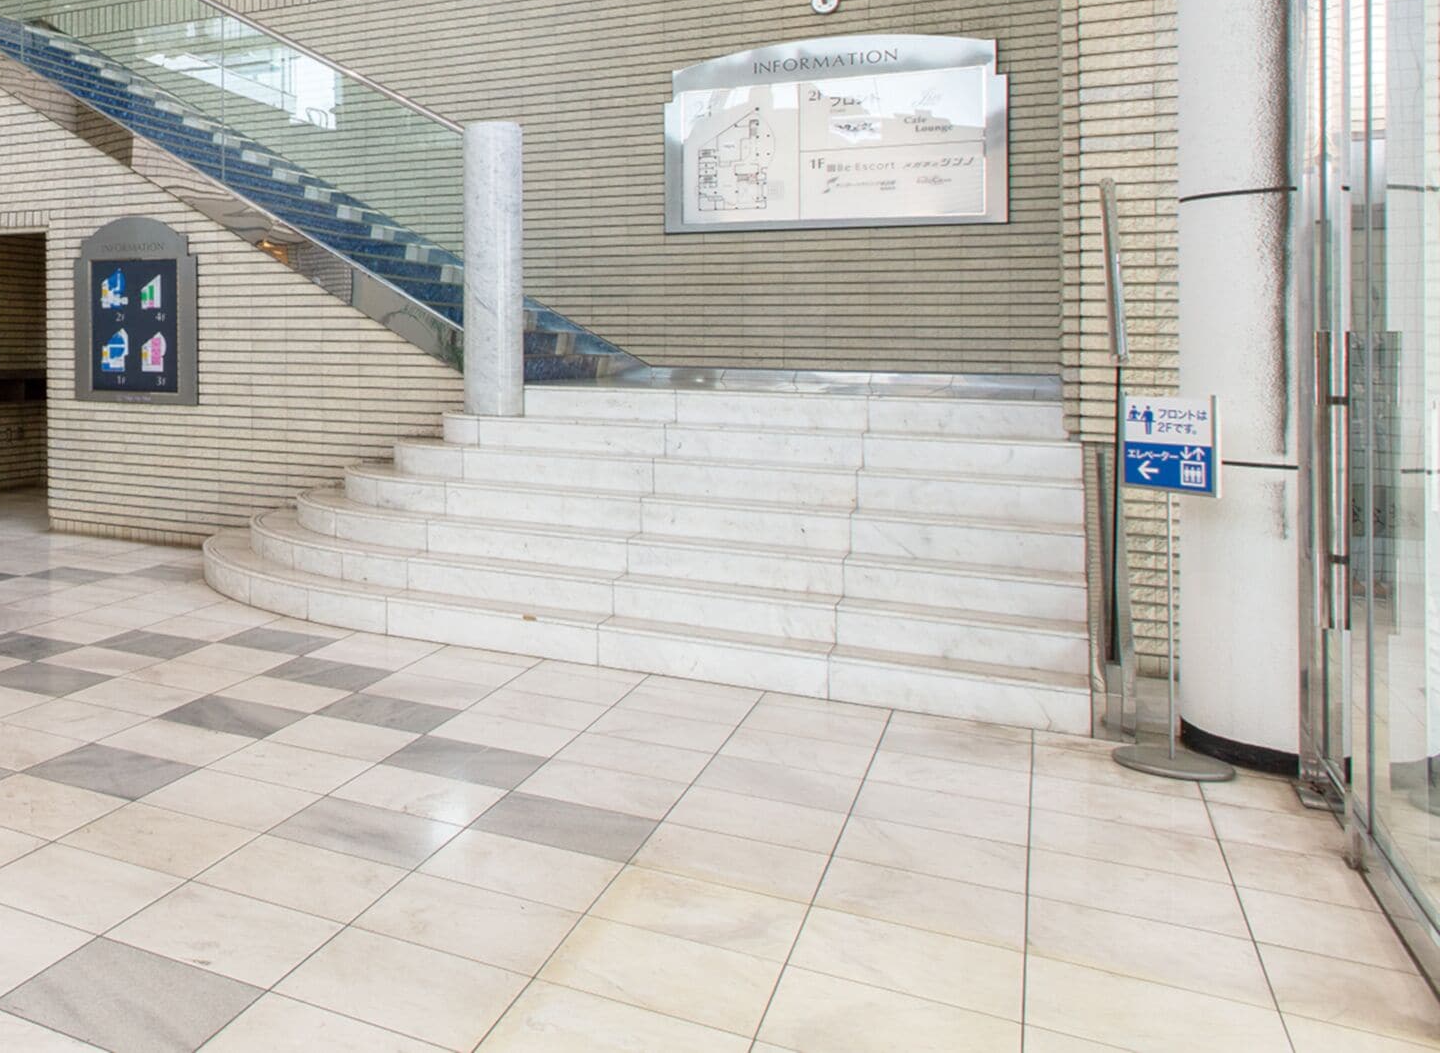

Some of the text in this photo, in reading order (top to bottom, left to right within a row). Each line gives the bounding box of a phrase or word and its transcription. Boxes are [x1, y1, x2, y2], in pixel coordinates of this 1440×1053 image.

[753, 48, 898, 75] INFORMATION
[915, 124, 953, 134] Lounge
[855, 162, 895, 172] Escort
[1158, 409, 1208, 421] フロントは
[1157, 422, 1197, 435] 2Fです。
[1128, 449, 1179, 461] エレベーター
